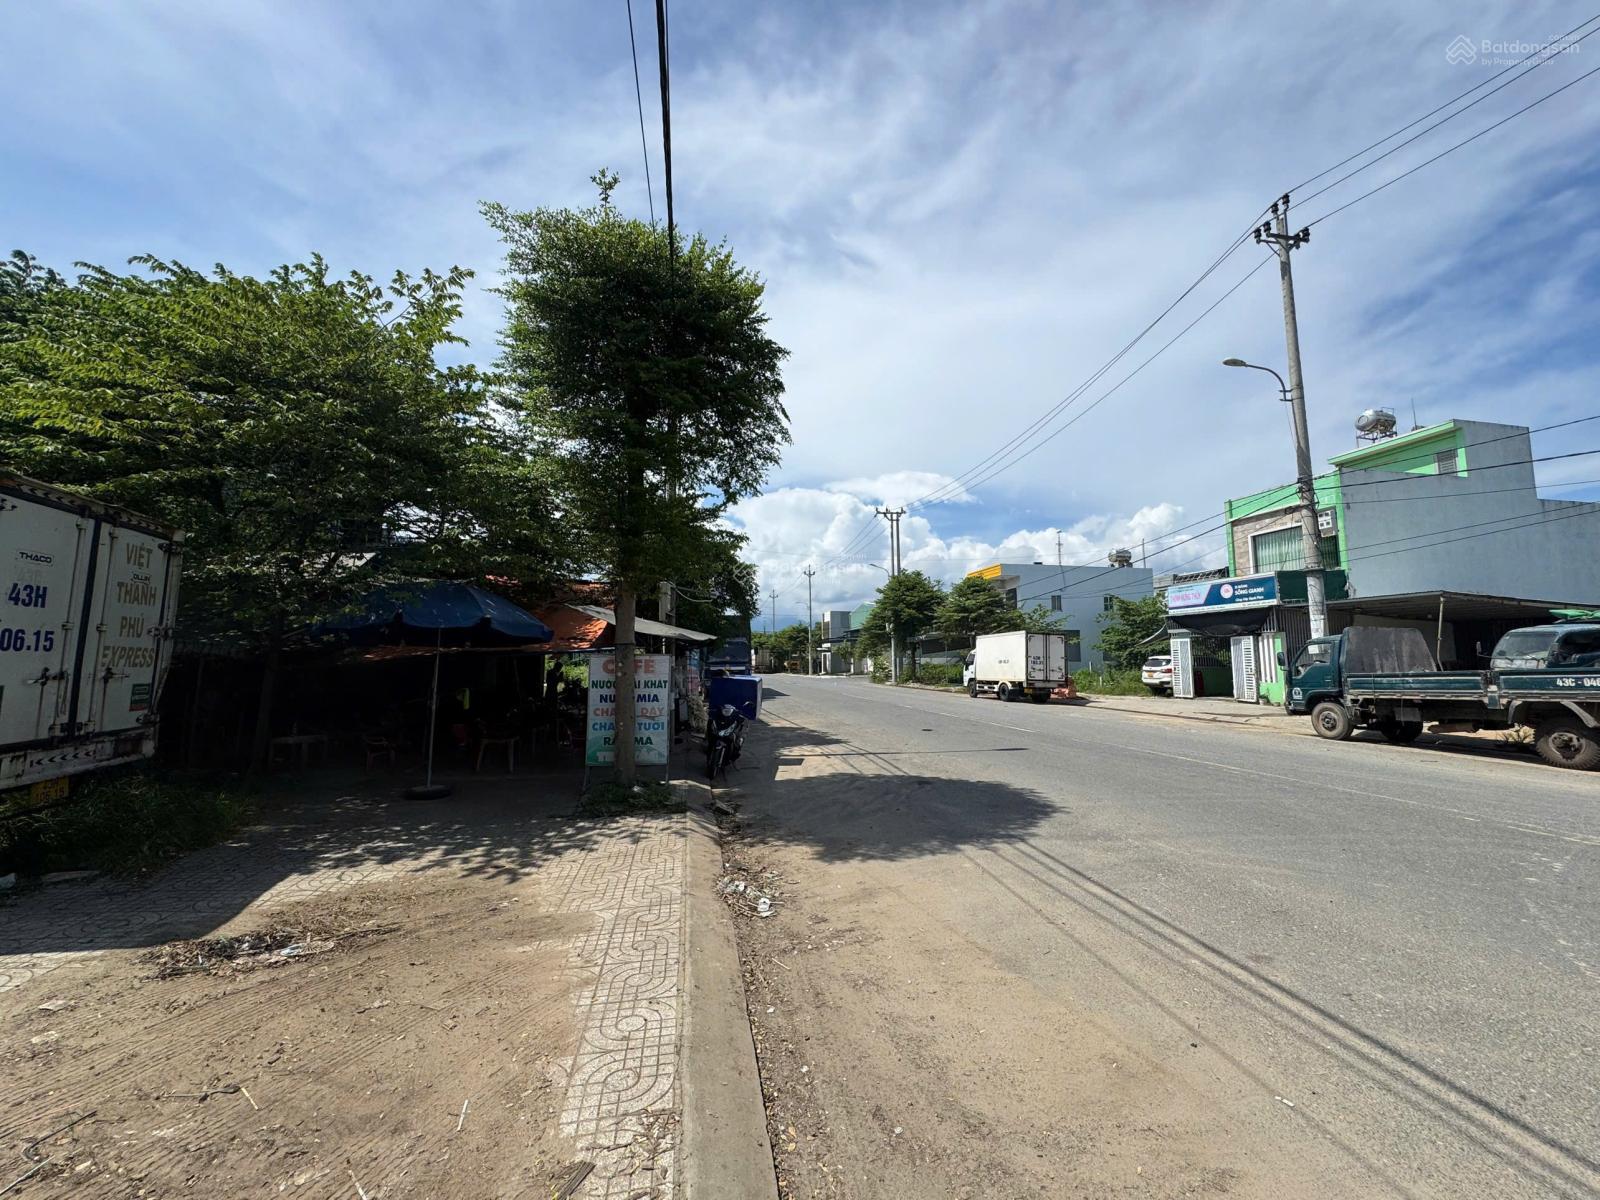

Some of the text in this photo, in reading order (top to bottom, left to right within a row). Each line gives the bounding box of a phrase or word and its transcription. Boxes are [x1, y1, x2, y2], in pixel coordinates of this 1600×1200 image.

[19, 551, 53, 564] THACO
[8, 583, 48, 609] 43H
[101, 645, 155, 668] EXPRESS
[602, 658, 655, 674] CFE
[1556, 677, 1576, 687] 43C
